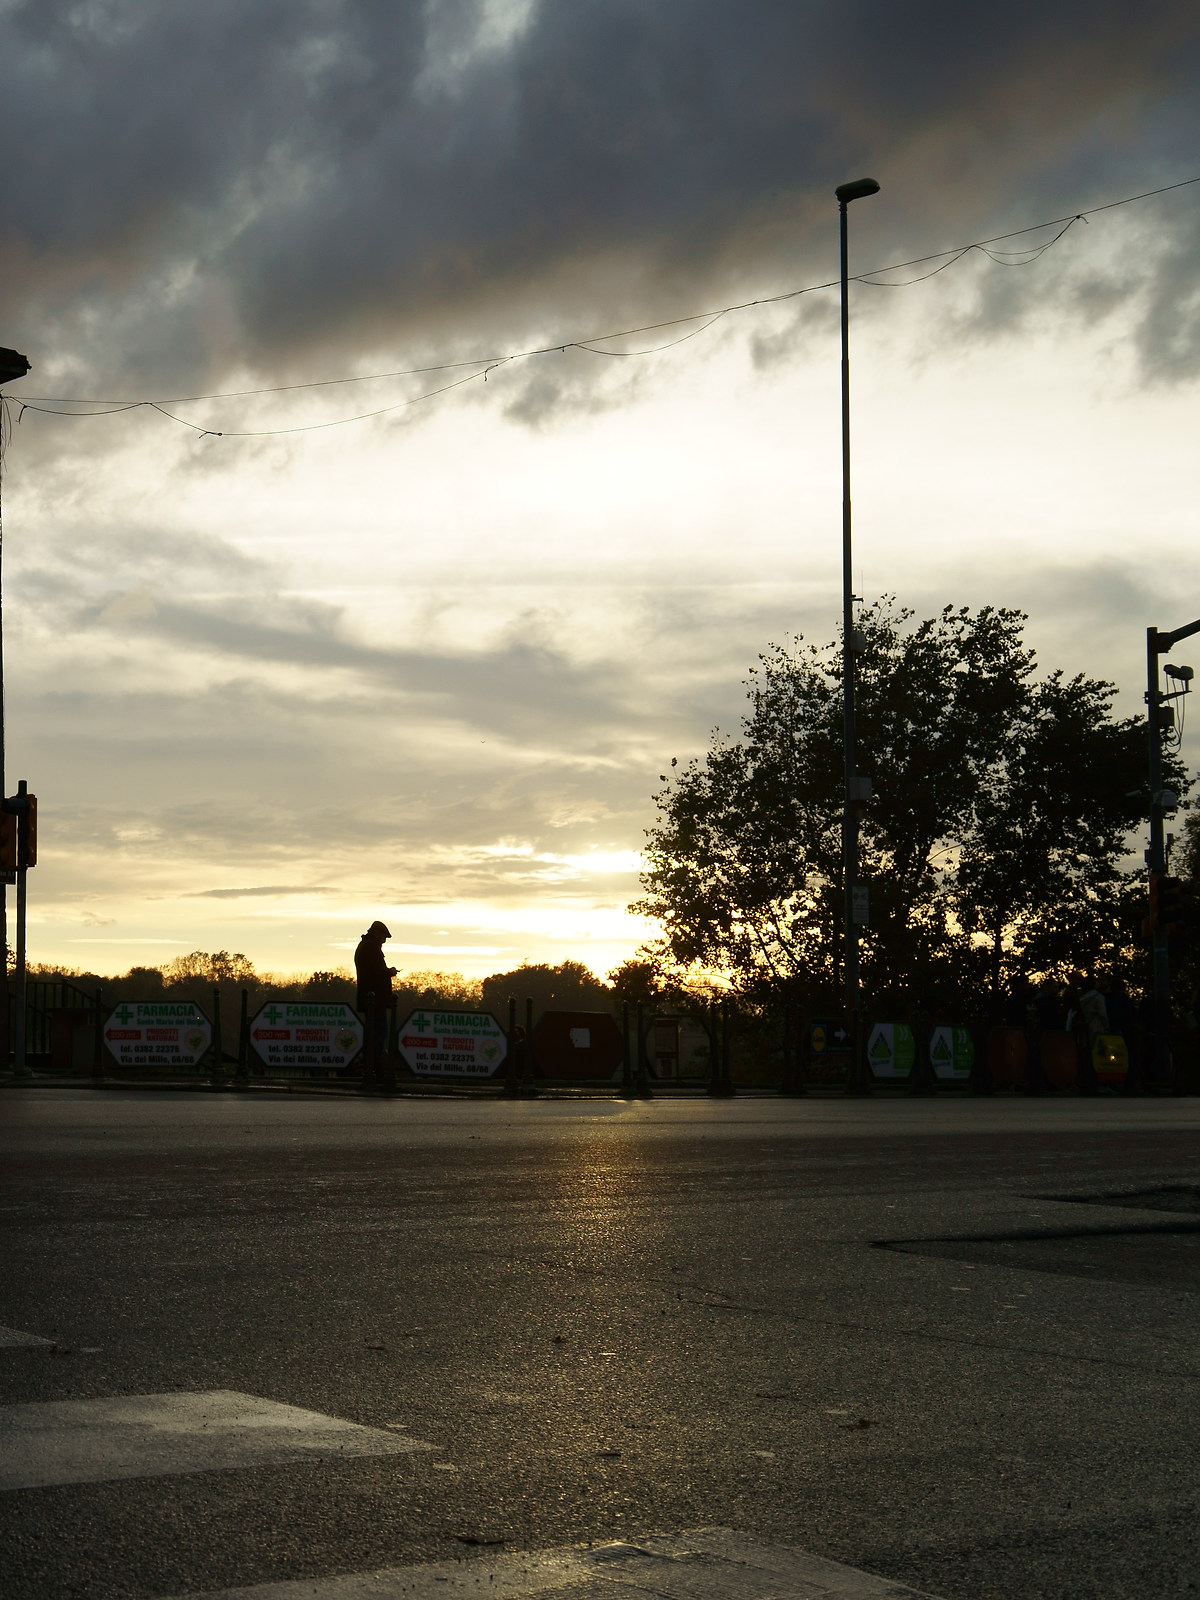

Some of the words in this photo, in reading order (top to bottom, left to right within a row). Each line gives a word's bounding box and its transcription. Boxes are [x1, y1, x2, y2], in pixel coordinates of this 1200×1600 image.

[137, 1005, 195, 1016] FARMACIA
[286, 1006, 346, 1017] FARMACIA
[433, 1014, 491, 1027] FARMACIA
[268, 1045, 281, 1053] tel.
[283, 1045, 303, 1053] 0382
[268, 1055, 280, 1063] Via
[430, 1053, 449, 1061] 0382
